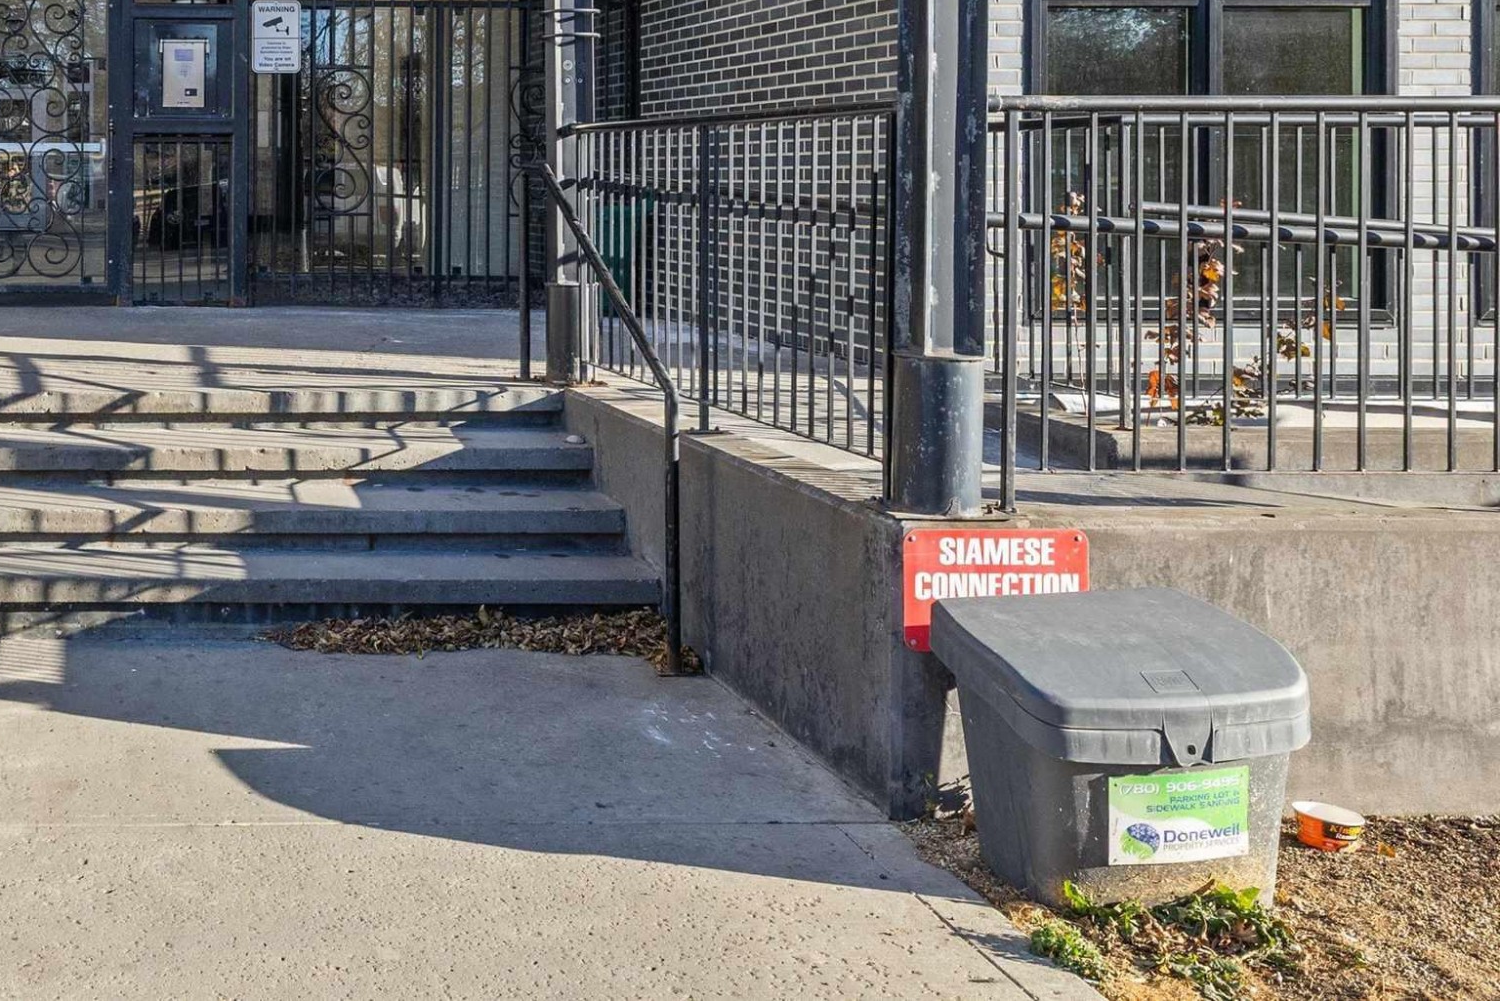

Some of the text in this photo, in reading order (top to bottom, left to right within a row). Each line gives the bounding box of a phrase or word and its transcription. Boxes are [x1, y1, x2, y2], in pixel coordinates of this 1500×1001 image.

[939, 537, 1055, 566] SIAMESE
[915, 571, 1079, 600] CONNECTION
[1120, 782, 1160, 795] (780)
[1146, 797, 1240, 813] SIDEWALK SANDING
[1170, 793, 1210, 804] PARKING
[1213, 791, 1229, 799] LOT
[1163, 823, 1240, 843] Donewell
[1163, 842, 1204, 851] PROPERTY
